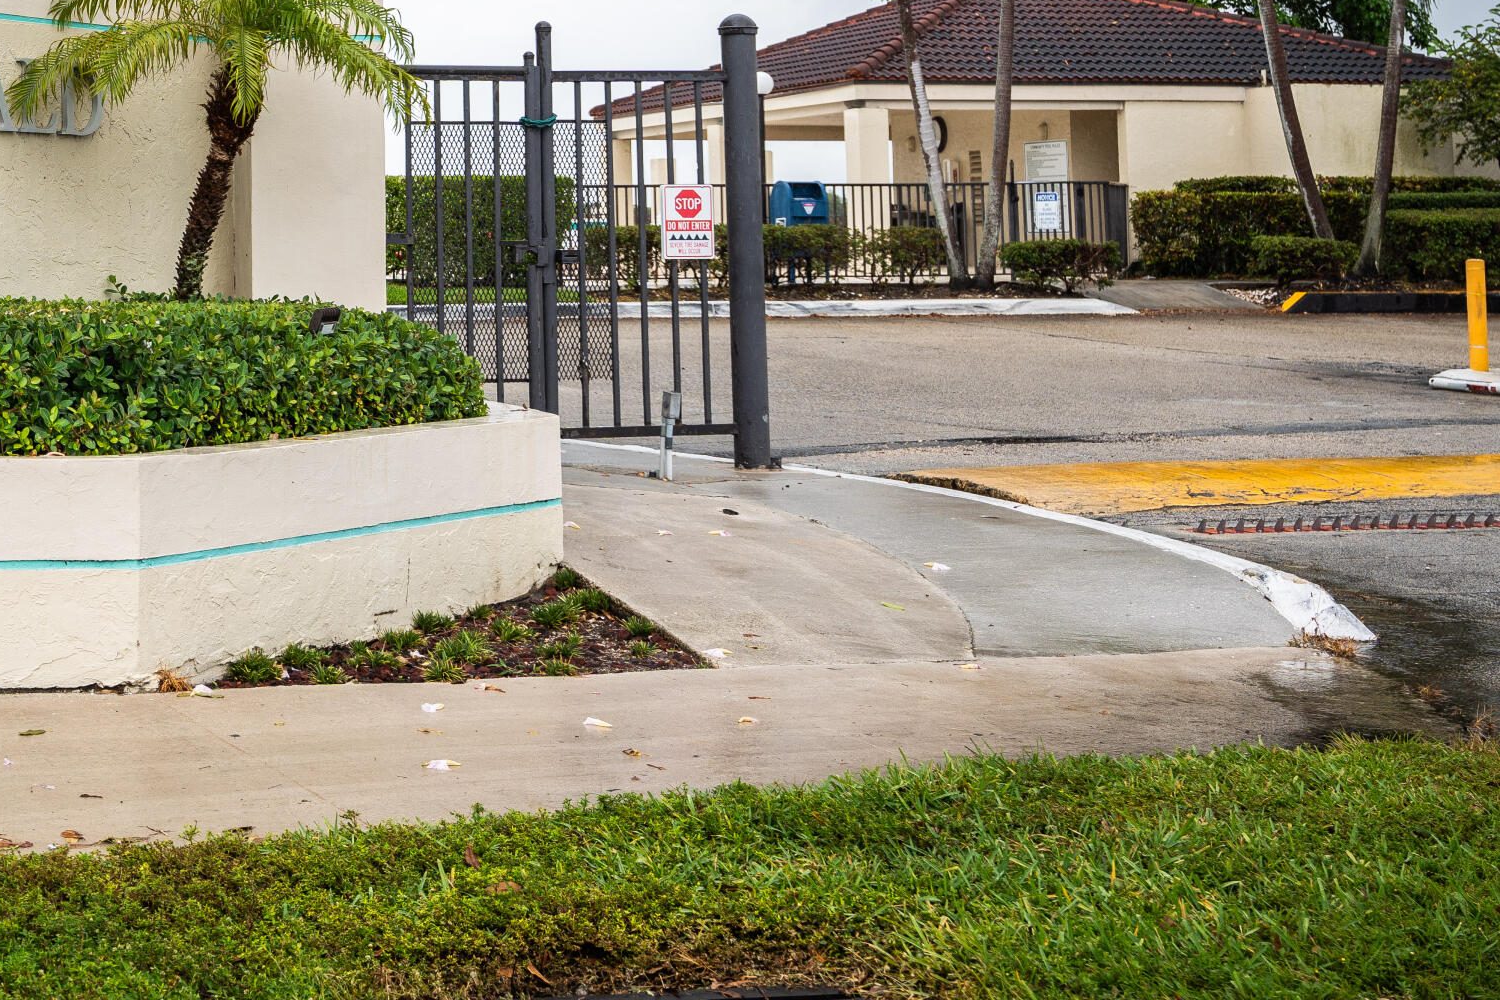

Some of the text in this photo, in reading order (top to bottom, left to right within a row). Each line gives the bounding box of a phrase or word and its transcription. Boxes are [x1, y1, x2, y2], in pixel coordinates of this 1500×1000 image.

[675, 198, 700, 209] STOP
[668, 221, 710, 230] DO NOT ENTER
